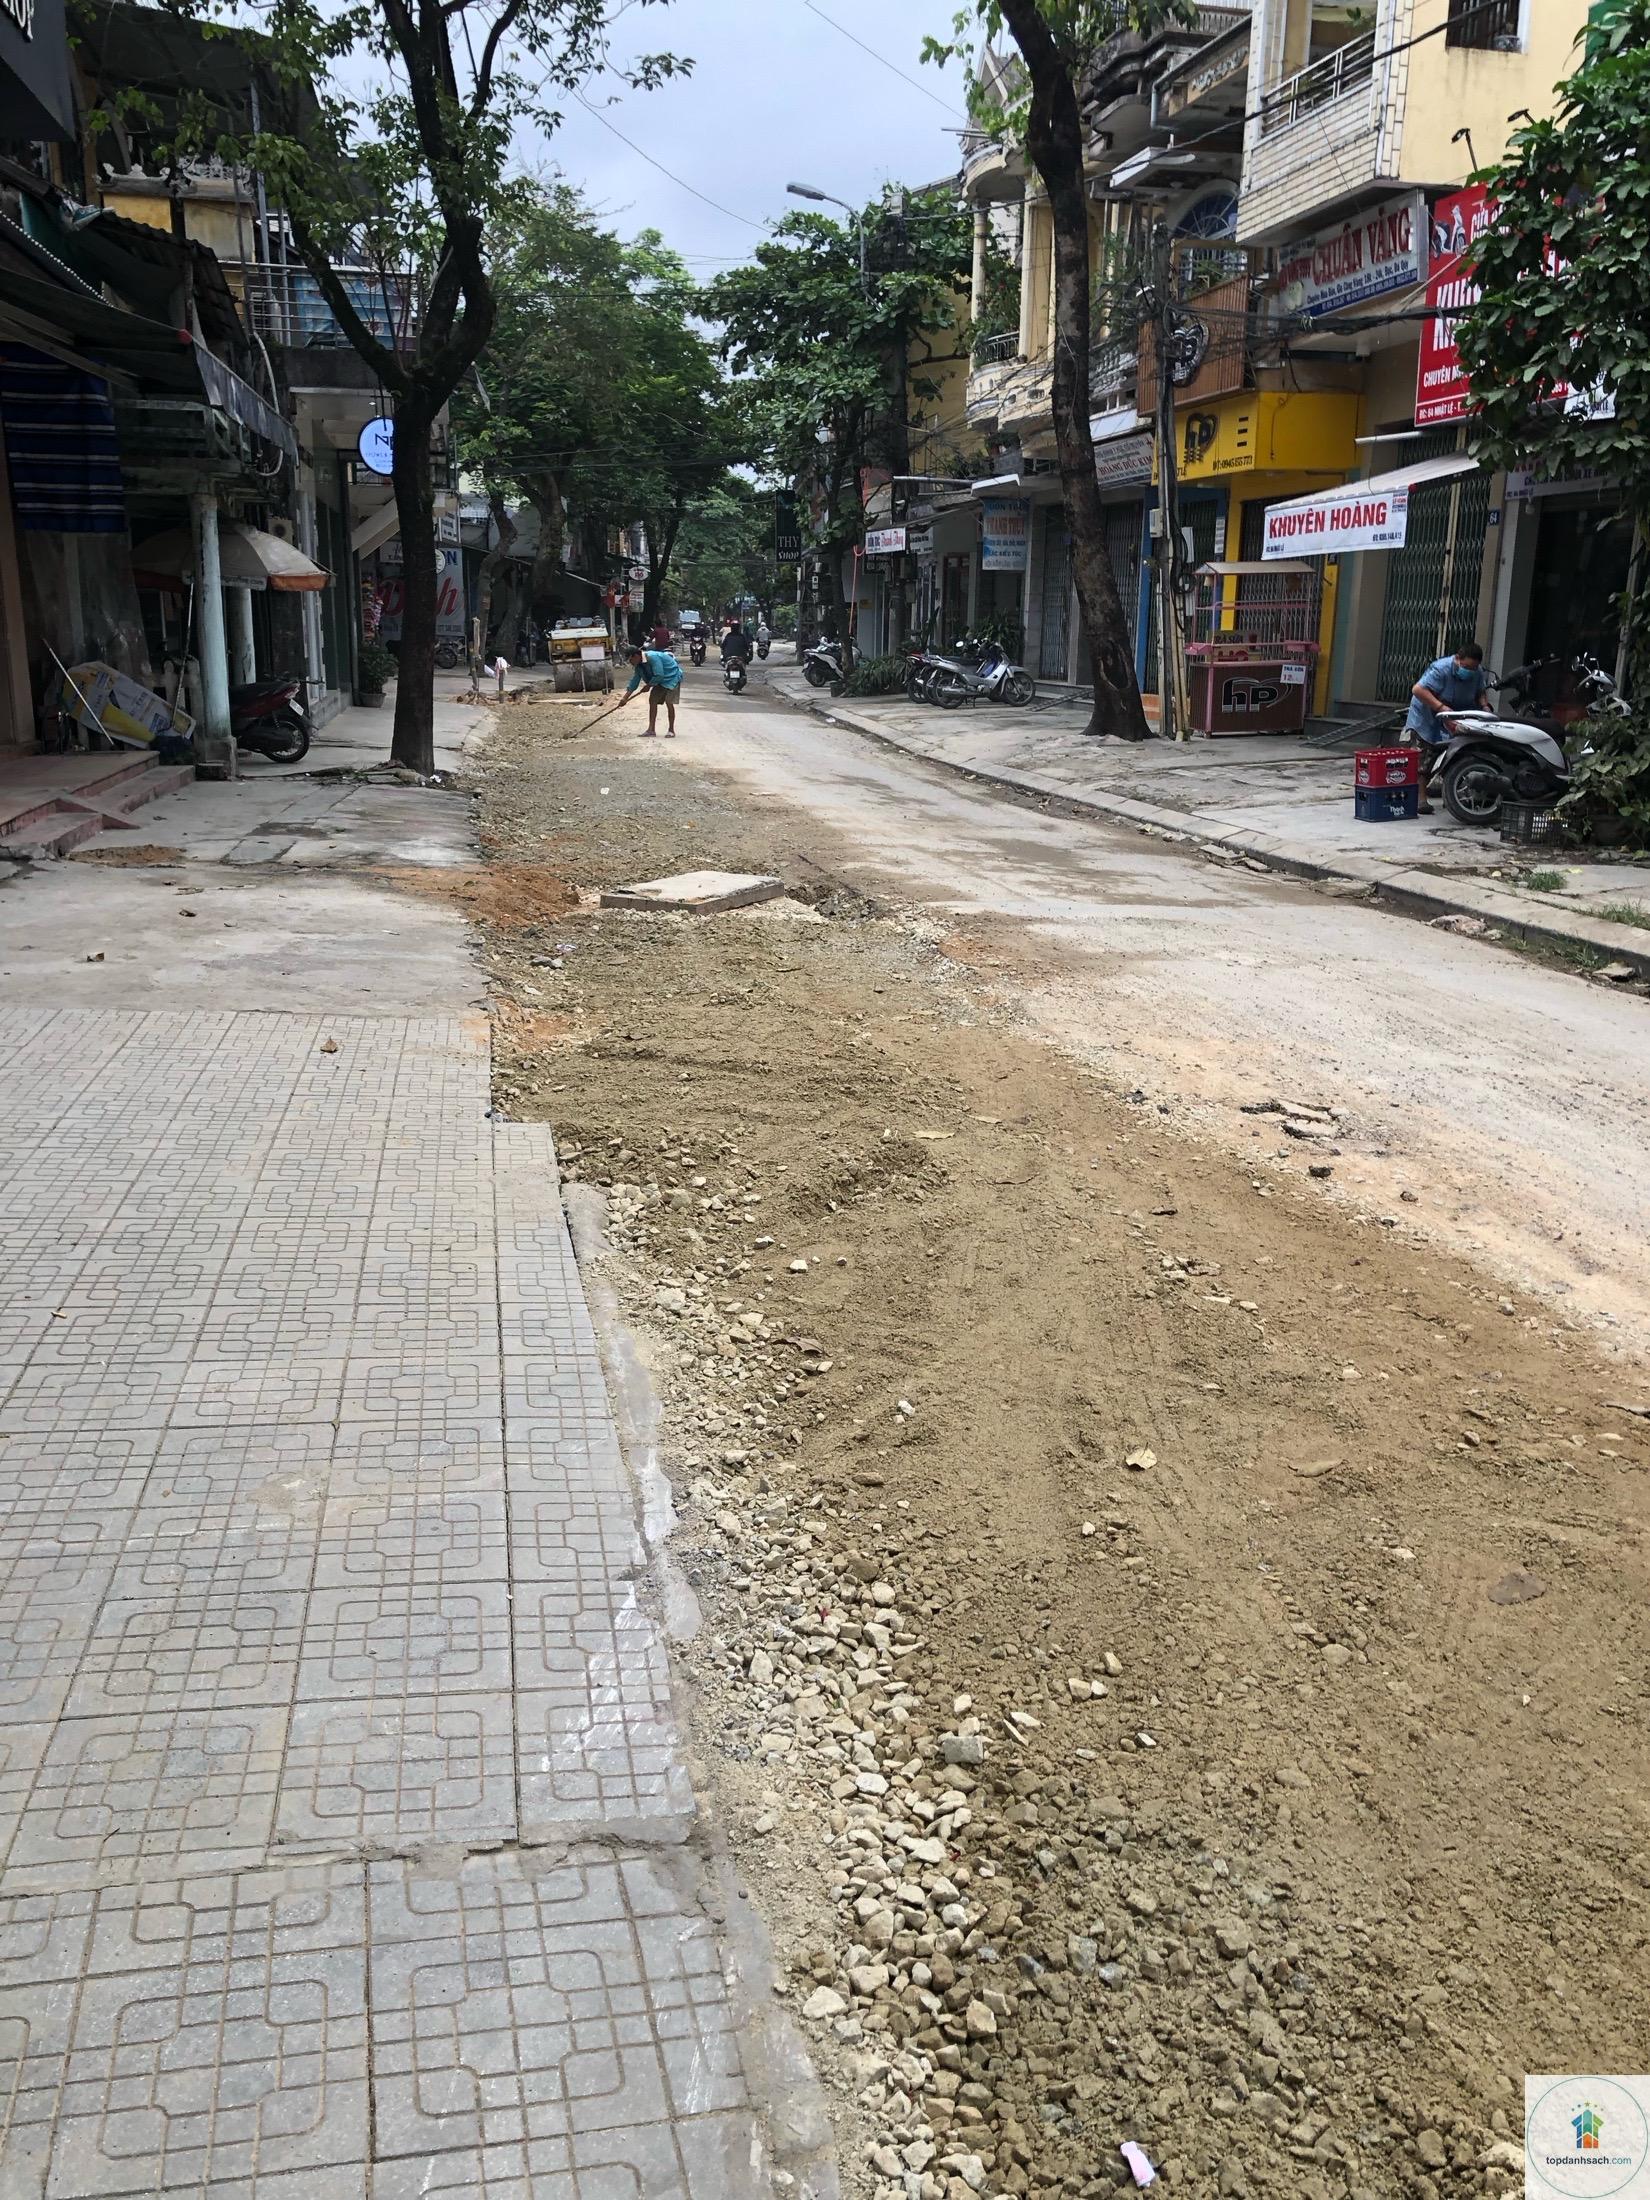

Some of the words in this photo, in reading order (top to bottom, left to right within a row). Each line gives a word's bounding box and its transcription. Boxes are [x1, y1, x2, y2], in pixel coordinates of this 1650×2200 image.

[1269, 508, 1325, 539] KHUYÊN
[1330, 501, 1387, 531] HOÀNG
[777, 535, 800, 548] THY
